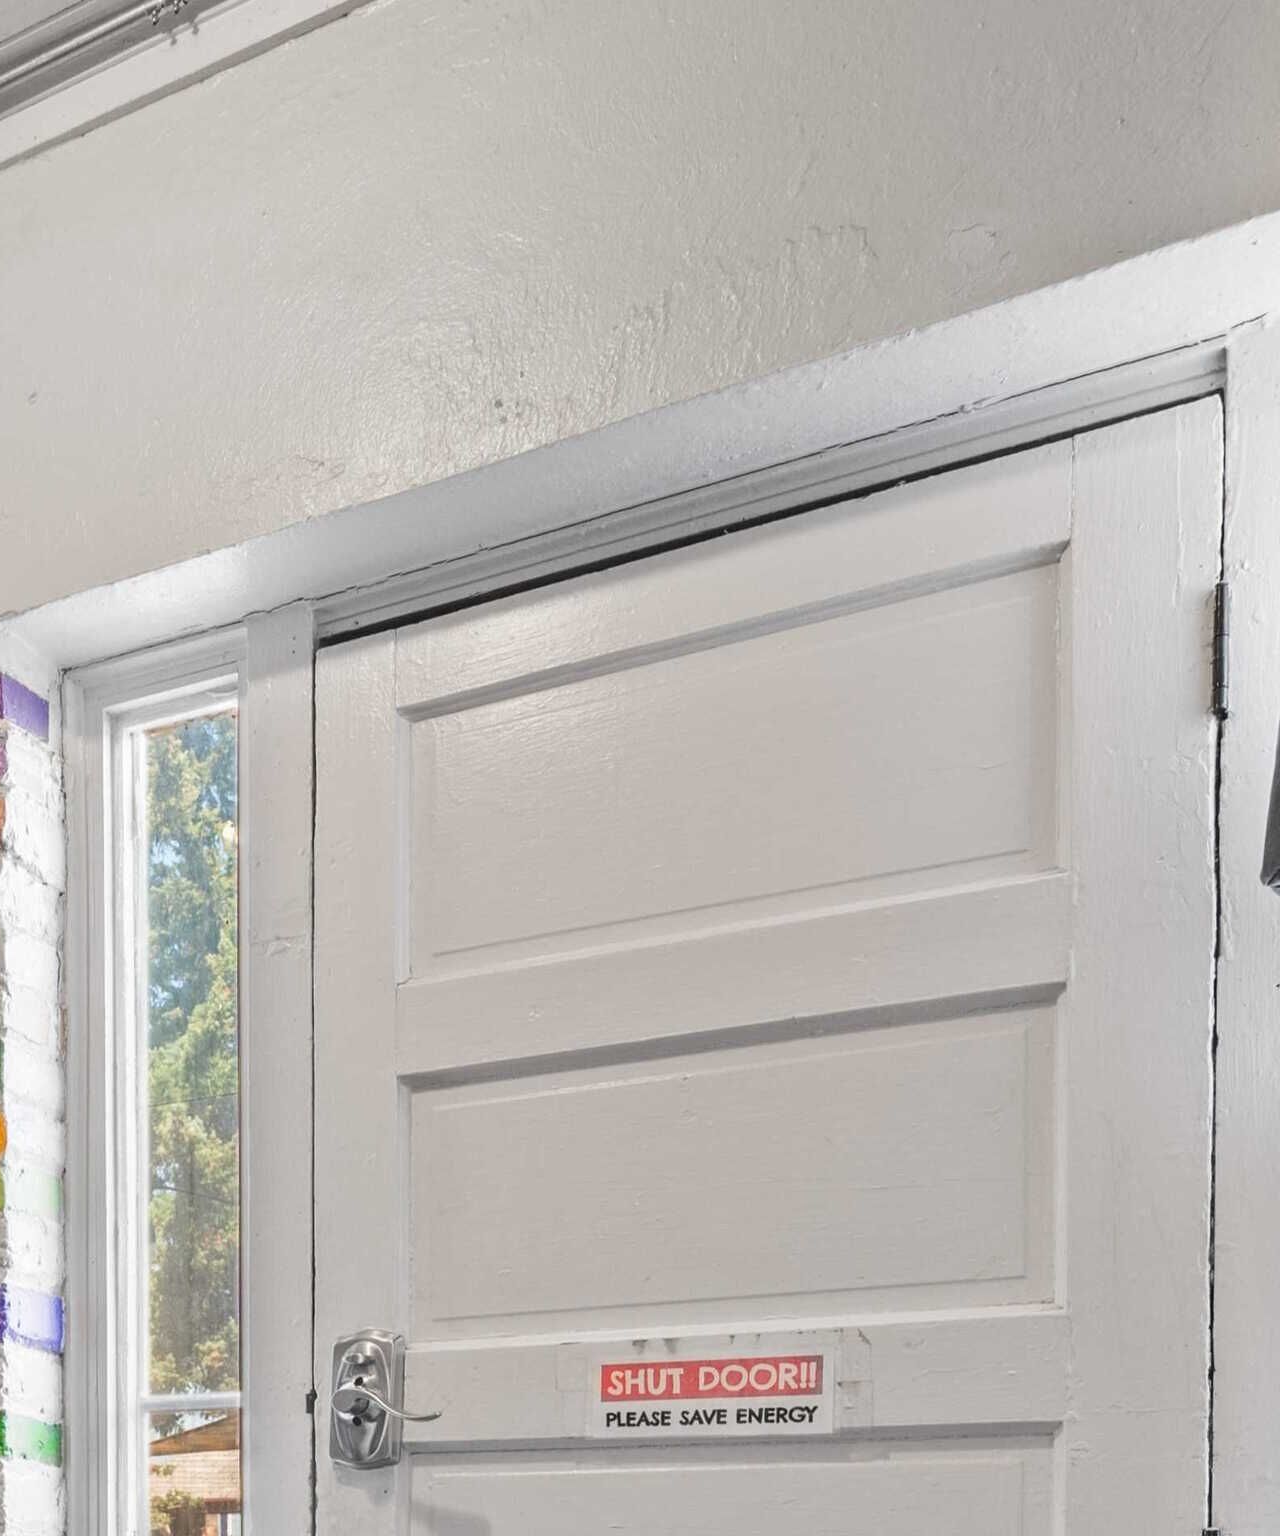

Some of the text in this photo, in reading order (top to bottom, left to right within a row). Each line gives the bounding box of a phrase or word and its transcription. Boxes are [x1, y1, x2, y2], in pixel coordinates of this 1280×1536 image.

[607, 1361, 818, 1397] SHUT DOOR!!
[606, 1405, 818, 1428] PLEASE SAVE ENERGY
